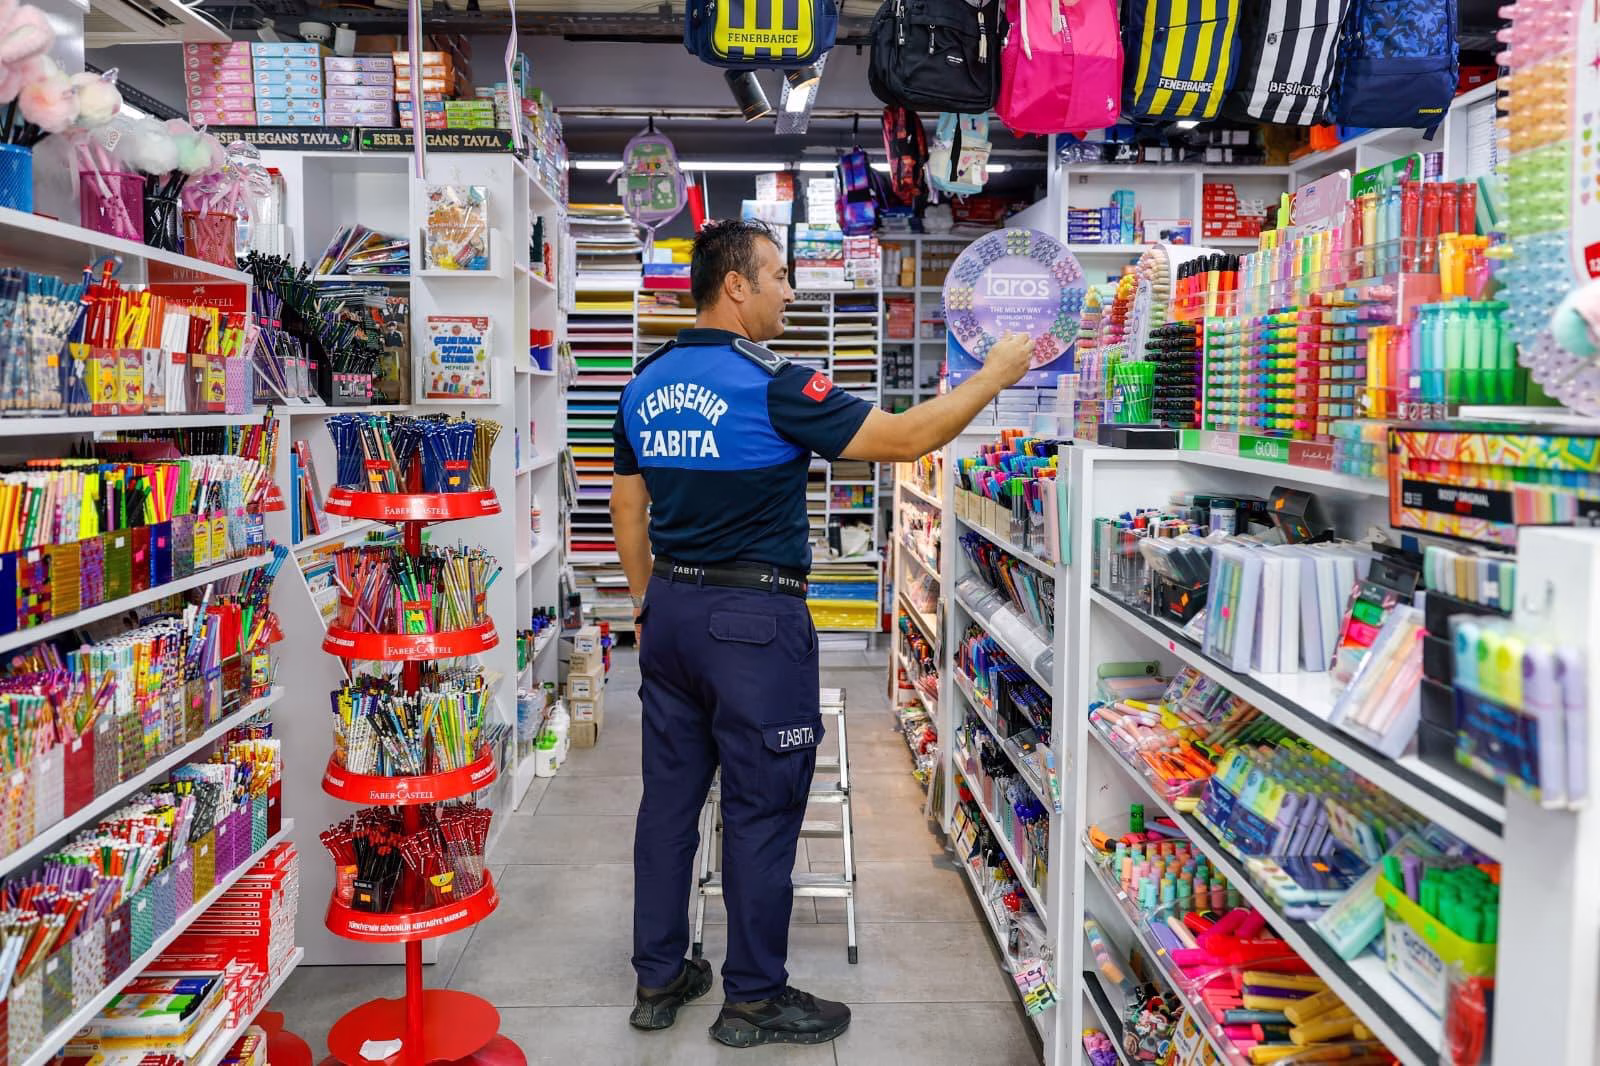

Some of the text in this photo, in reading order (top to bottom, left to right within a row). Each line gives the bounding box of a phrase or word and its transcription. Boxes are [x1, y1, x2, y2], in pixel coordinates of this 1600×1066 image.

[245, 133, 299, 145] ELEGANS
[300, 134, 341, 146] TAVLA
[373, 133, 502, 148] ESER EGANS TAVLA
[1006, 306, 1026, 314] MILKY
[640, 430, 720, 458] ZABITA
[1255, 440, 1279, 458] GLOW
[384, 507, 449, 515] FABERASTELL
[778, 727, 814, 748] ZABITA
[370, 790, 434, 800] FABER-CASTELL
